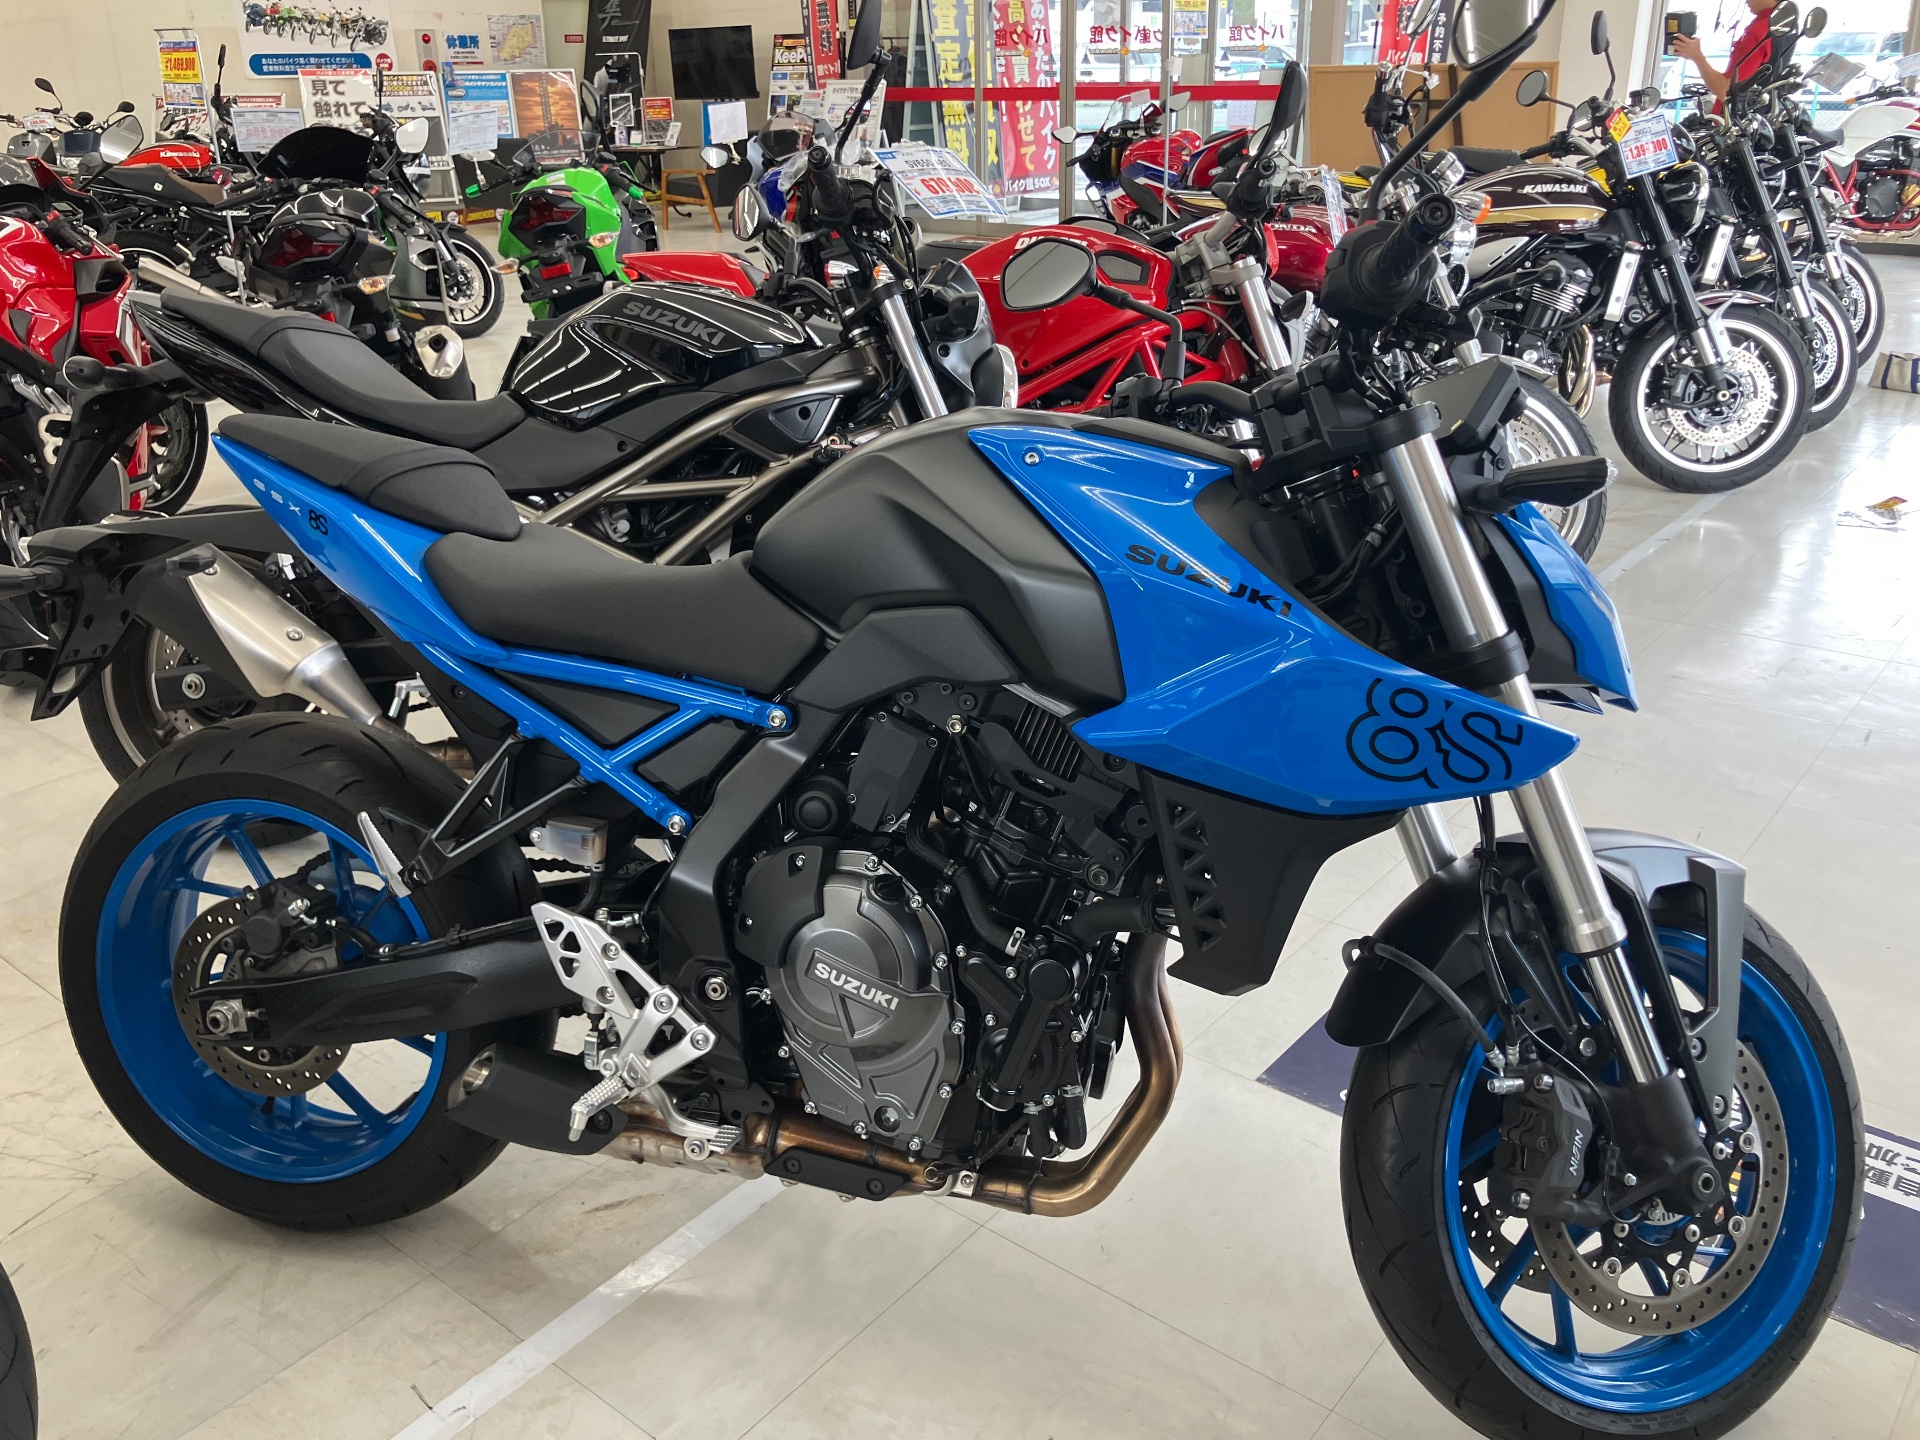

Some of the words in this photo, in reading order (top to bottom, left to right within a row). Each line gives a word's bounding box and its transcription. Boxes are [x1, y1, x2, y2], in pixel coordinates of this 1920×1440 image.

[446, 34, 480, 49] 休憩所
[775, 47, 807, 64] KeeP
[311, 79, 345, 96] 見て
[313, 101, 366, 118] 触れて
[1523, 183, 1588, 194] KAWASAKI
[622, 301, 726, 346] SUZUKI
[1125, 544, 1293, 618] SUZUKI
[814, 962, 899, 1011] SUZUKI
